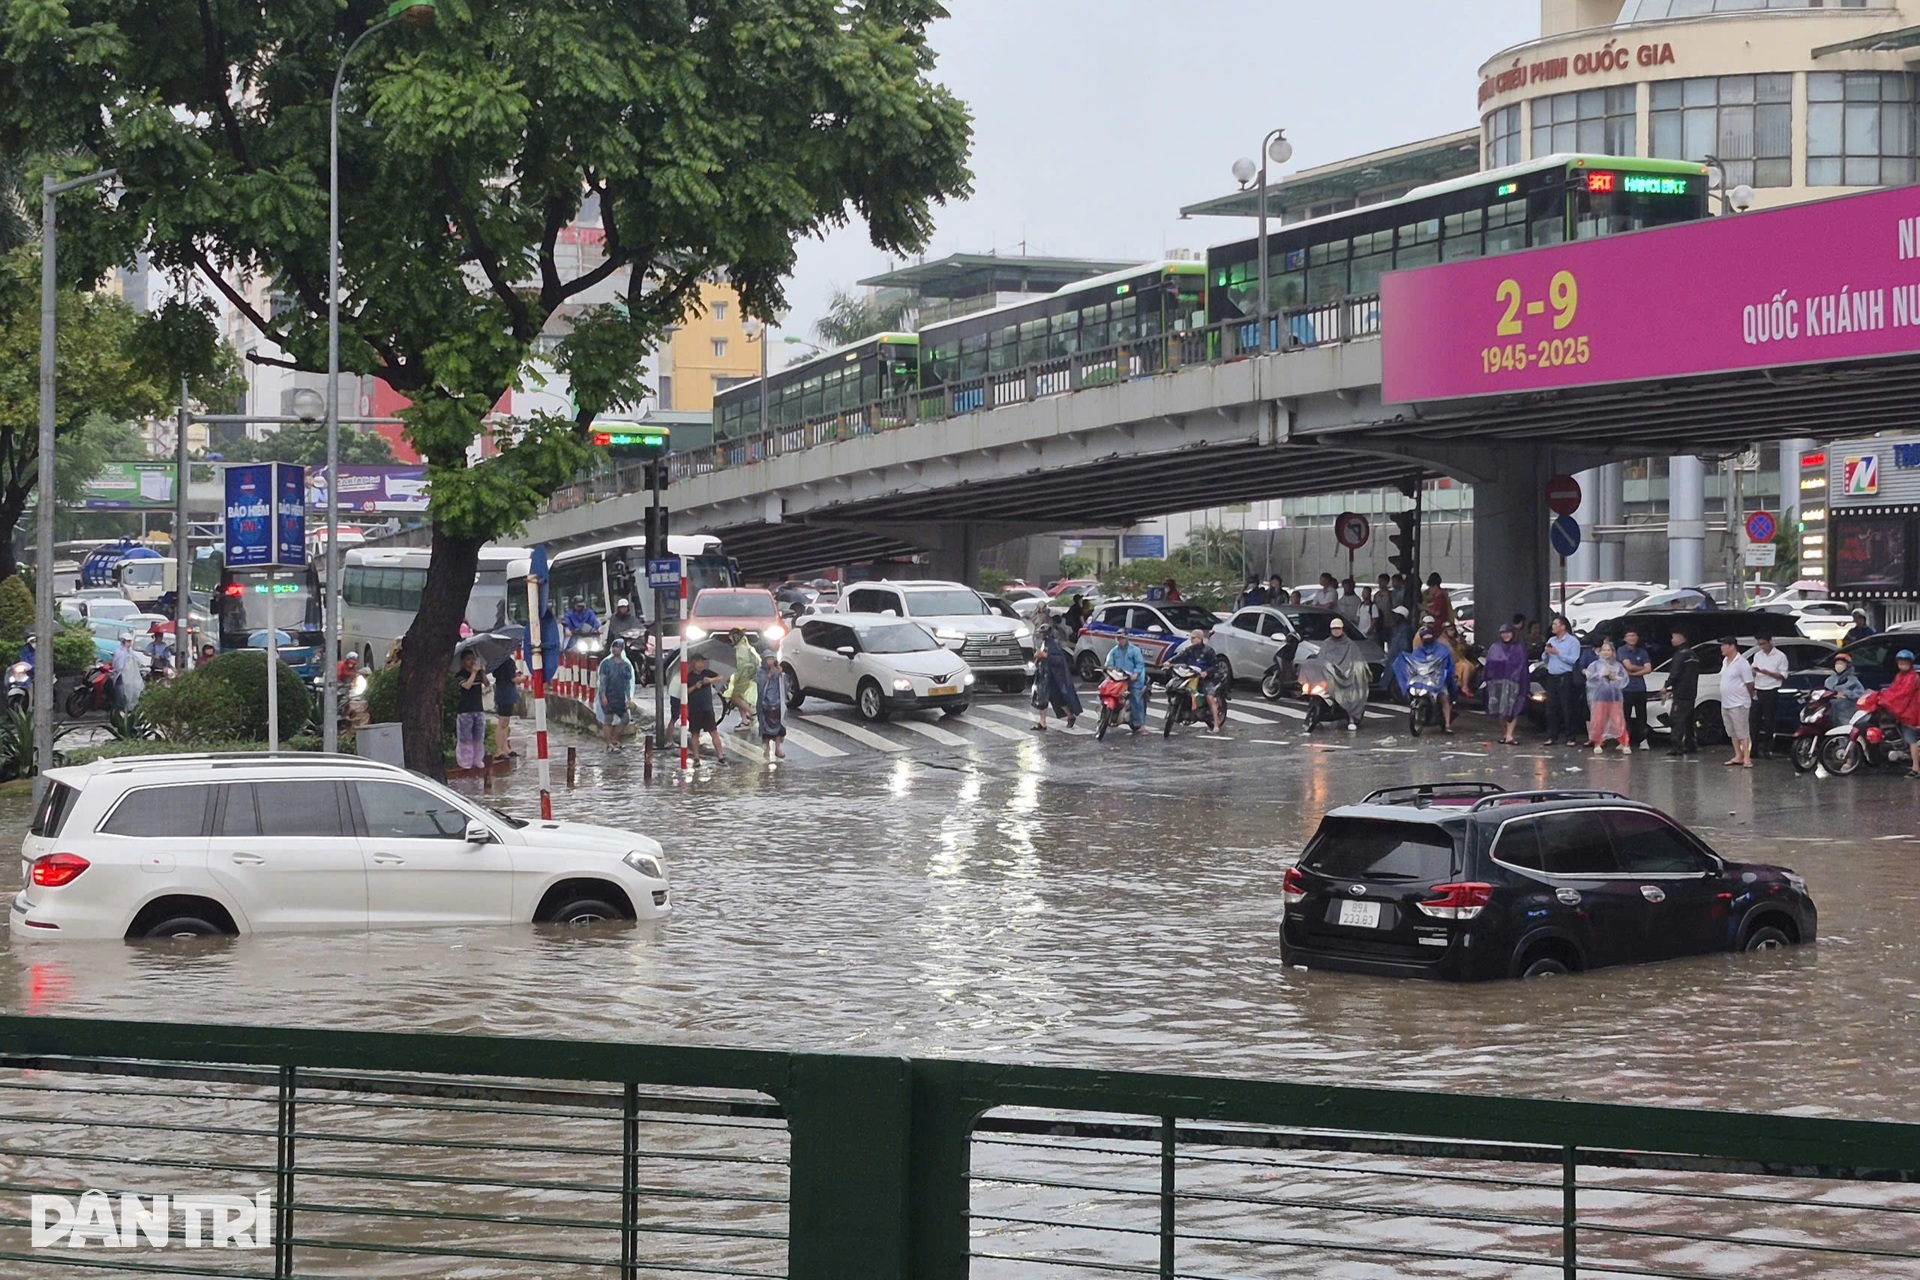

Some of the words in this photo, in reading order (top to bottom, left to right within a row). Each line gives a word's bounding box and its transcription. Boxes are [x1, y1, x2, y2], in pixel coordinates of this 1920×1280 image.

[1530, 57, 1568, 84] PHIM
[1573, 38, 1629, 76] QUỐC
[1637, 42, 1675, 68] GIA
[1496, 270, 1578, 336] 2-9
[1743, 289, 1798, 344] QUỐC
[1806, 285, 1884, 337] KHÁNH
[1481, 336, 1589, 373] 1945-2025
[227, 502, 247, 518] BẢO
